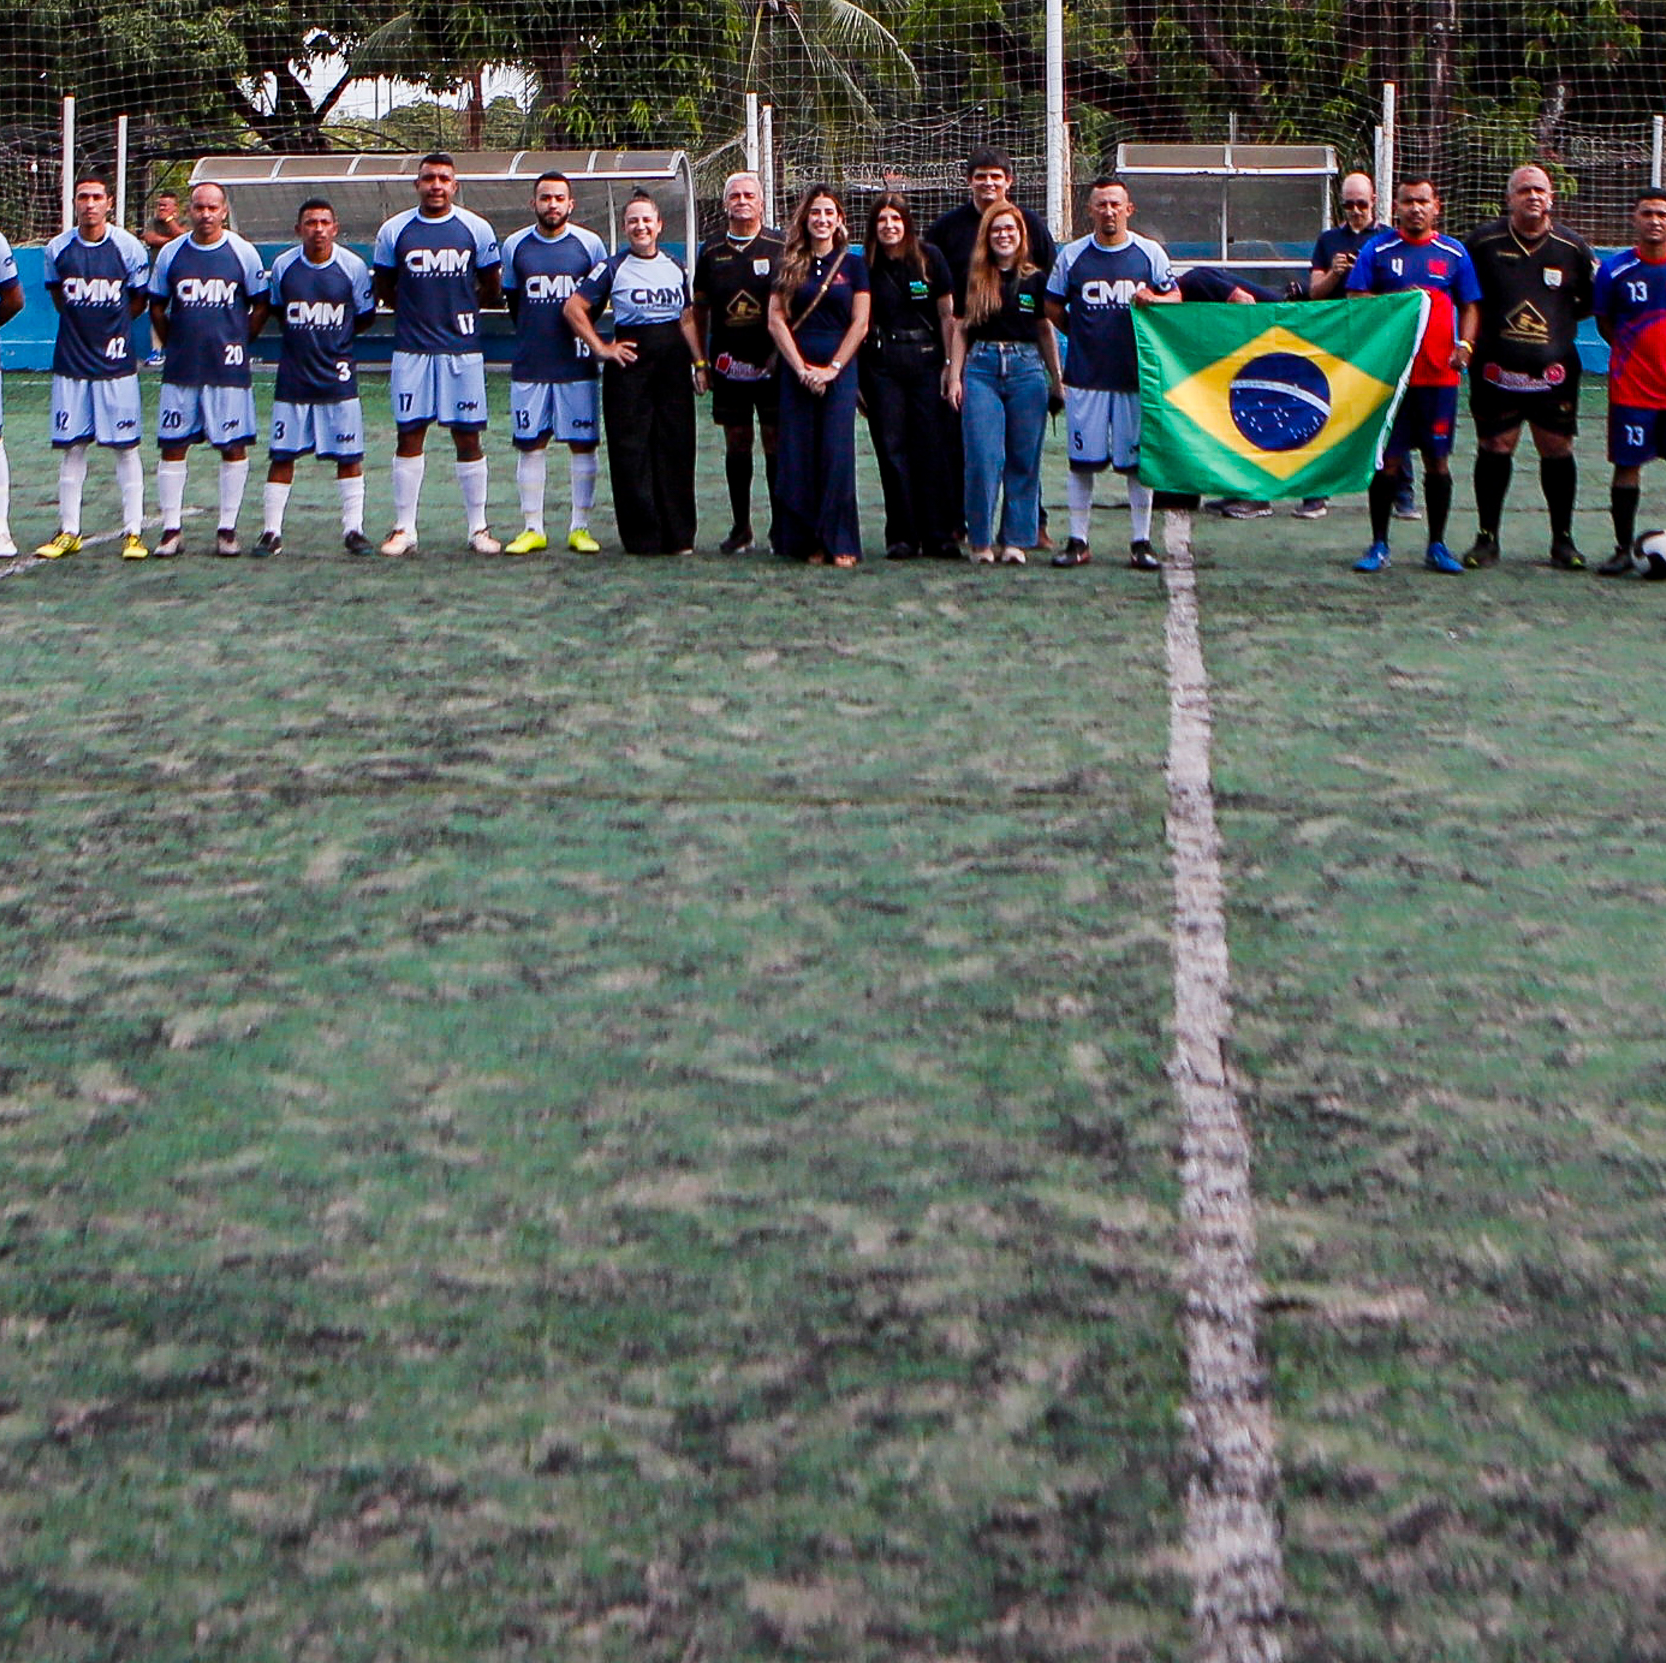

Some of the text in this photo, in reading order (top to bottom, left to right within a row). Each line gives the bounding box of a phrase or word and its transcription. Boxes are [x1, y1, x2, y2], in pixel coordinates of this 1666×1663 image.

[405, 248, 472, 273] CMM
[1391, 257, 1404, 277] 4
[62, 277, 123, 303] CMM
[177, 278, 238, 304] CMM
[630, 288, 683, 305] CMM
[1082, 280, 1147, 305] CMM
[1626, 281, 1648, 302] 13
[286, 301, 345, 326] CMM
[224, 344, 244, 366] 20
[335, 361, 352, 382] 3
[399, 393, 413, 412] 17
[162, 409, 181, 429] 20
[515, 409, 531, 430] 13
[1074, 431, 1083, 451] 5
[1624, 423, 1645, 447] 13
